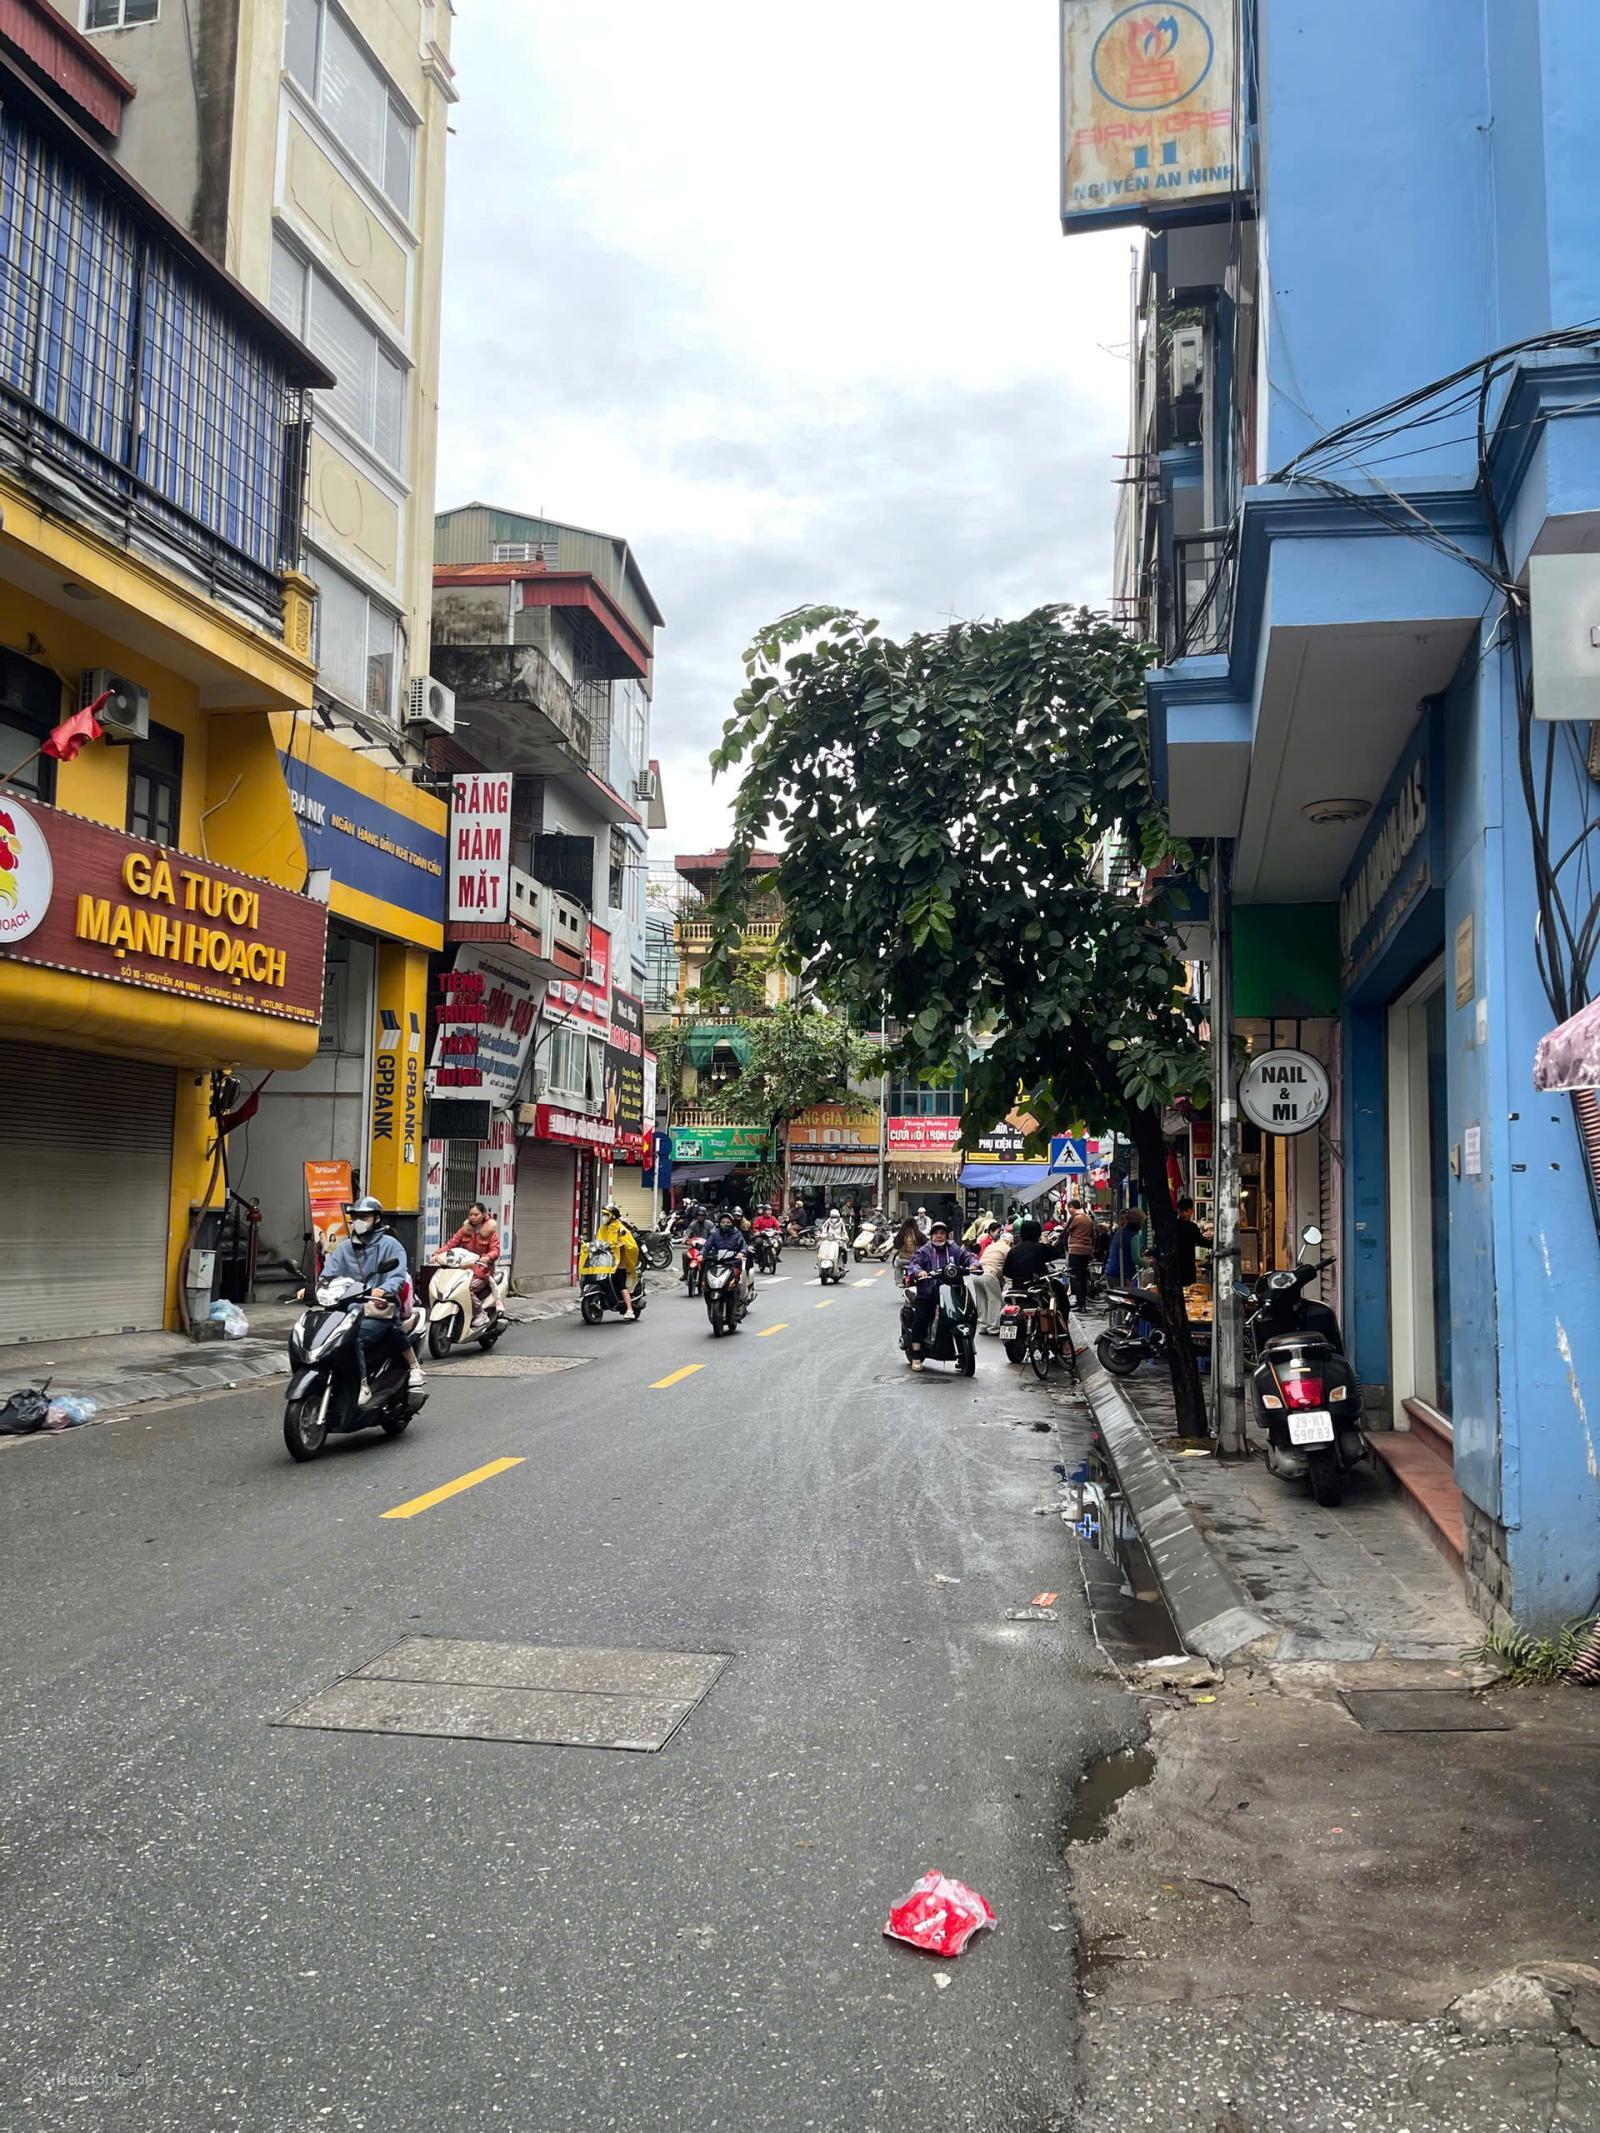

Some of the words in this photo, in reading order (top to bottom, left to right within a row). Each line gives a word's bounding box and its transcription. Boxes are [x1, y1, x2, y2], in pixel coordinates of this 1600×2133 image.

[1075, 122, 1151, 145] SIAM
[1164, 109, 1231, 133] GAS
[1155, 171, 1181, 189] AN
[1188, 164, 1234, 185] NINH
[287, 788, 326, 826] BANK
[454, 776, 508, 813] RĂNG
[331, 813, 355, 836] NGÂN
[357, 825, 380, 847] HÀNG
[457, 822, 502, 860] HÀM
[122, 850, 176, 904] GÀ
[179, 870, 260, 929] TƯƠI
[458, 869, 500, 914] MẶT
[0, 909, 30, 931] OẠCH
[76, 893, 182, 961] MẠNH
[184, 923, 288, 987] HOẠCH
[1262, 1066, 1307, 1083] NAIL
[374, 1055, 396, 1141] GPBANK
[404, 1057, 418, 1141] GPBANK
[1280, 1088, 1290, 1100] &
[821, 1111, 843, 1125] GIA
[1273, 1104, 1297, 1120] MI
[793, 1154, 825, 1163] 291
[979, 1139, 993, 1151] PHỤ
[995, 1137, 1011, 1151] KIỆN
